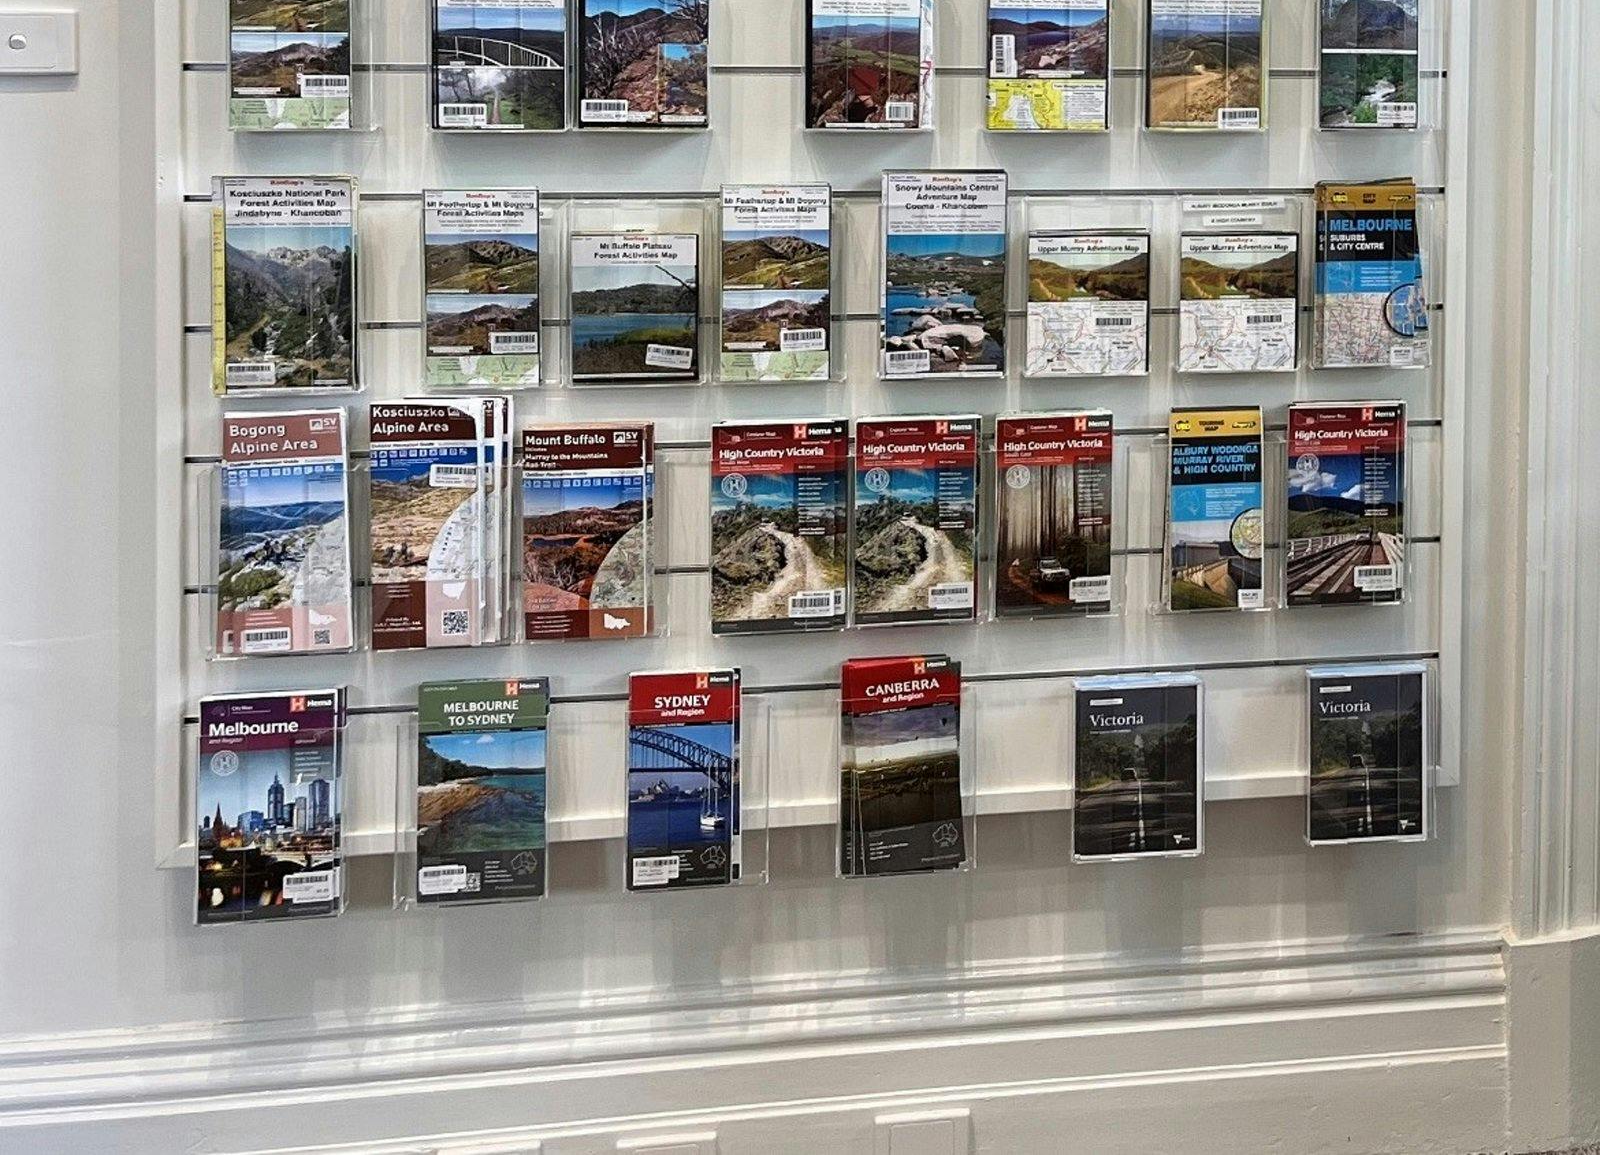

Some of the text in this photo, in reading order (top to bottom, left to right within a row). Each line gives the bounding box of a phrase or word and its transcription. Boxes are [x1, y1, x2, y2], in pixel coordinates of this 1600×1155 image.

[895, 184, 922, 192] Snowy
[316, 200, 336, 208] Map
[235, 209, 342, 218] Jindabyne Khancoban
[1330, 219, 1413, 231] MELBOURNE
[1355, 242, 1384, 250] CENTRE
[372, 407, 445, 418] Kosciuszko
[229, 425, 285, 439] Bogong
[372, 421, 449, 436] Alpine Area
[1295, 429, 1388, 440] High Country Victoria
[525, 434, 606, 445] Mount Buffalo
[1004, 439, 1103, 452] High Country Victoria
[231, 440, 317, 455] Alpine Area
[720, 447, 824, 460] High Country Victoria
[863, 442, 965, 455] High Country Victoria
[1173, 445, 1258, 456] ALBURY WODONGA
[1173, 455, 1244, 465] MURRAY RIVER
[1173, 463, 1256, 475] & HIGH COUNTRY
[866, 678, 940, 697] CANBERRA
[307, 699, 332, 707] Hema
[655, 694, 710, 708] SYDNEY
[882, 692, 924, 703] and Region
[444, 700, 519, 712] MELBOURNE
[1319, 700, 1371, 714] Victoria
[677, 708, 705, 717] Region
[448, 714, 515, 726] TO SYDNEY
[1089, 712, 1143, 726] Victoria
[209, 721, 299, 736] Melbourne
